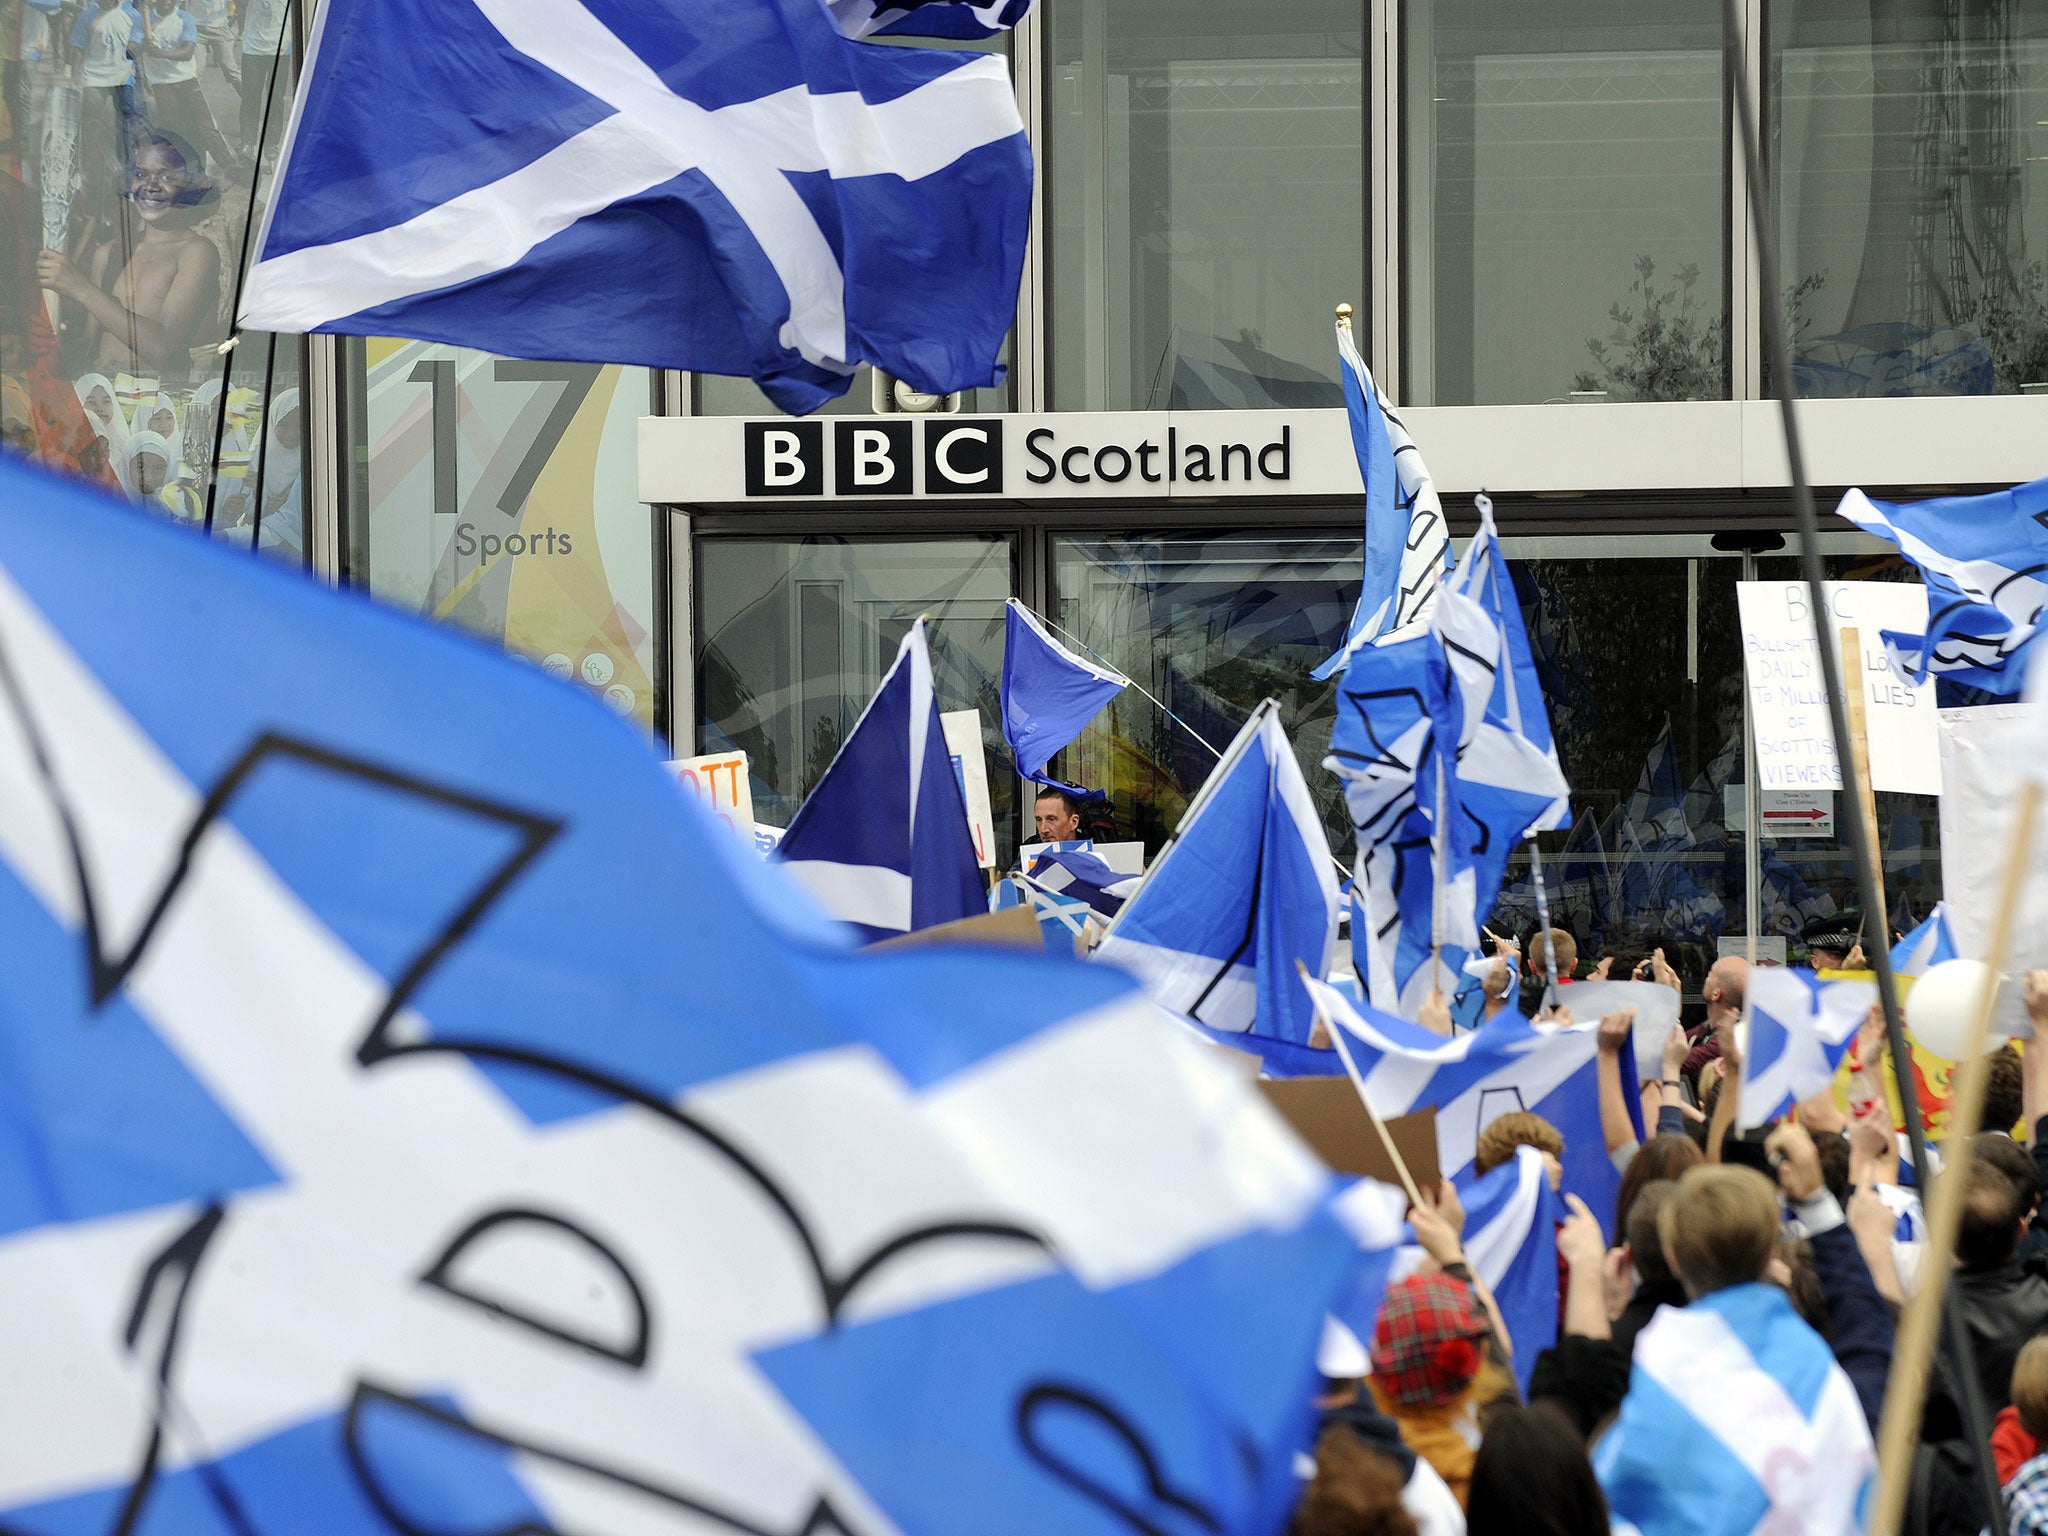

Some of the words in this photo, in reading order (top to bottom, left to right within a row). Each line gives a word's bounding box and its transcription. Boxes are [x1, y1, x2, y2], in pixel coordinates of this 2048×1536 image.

[406, 359, 605, 518] 17
[763, 427, 990, 487] BBC
[1025, 425, 1291, 485] Scotland
[456, 523, 573, 566] Sports
[1746, 633, 1824, 653] BULLSHIT
[1760, 659, 1812, 678] DAILY
[1871, 683, 1917, 707] LIES
[1764, 763, 1842, 783] VIEWERS
